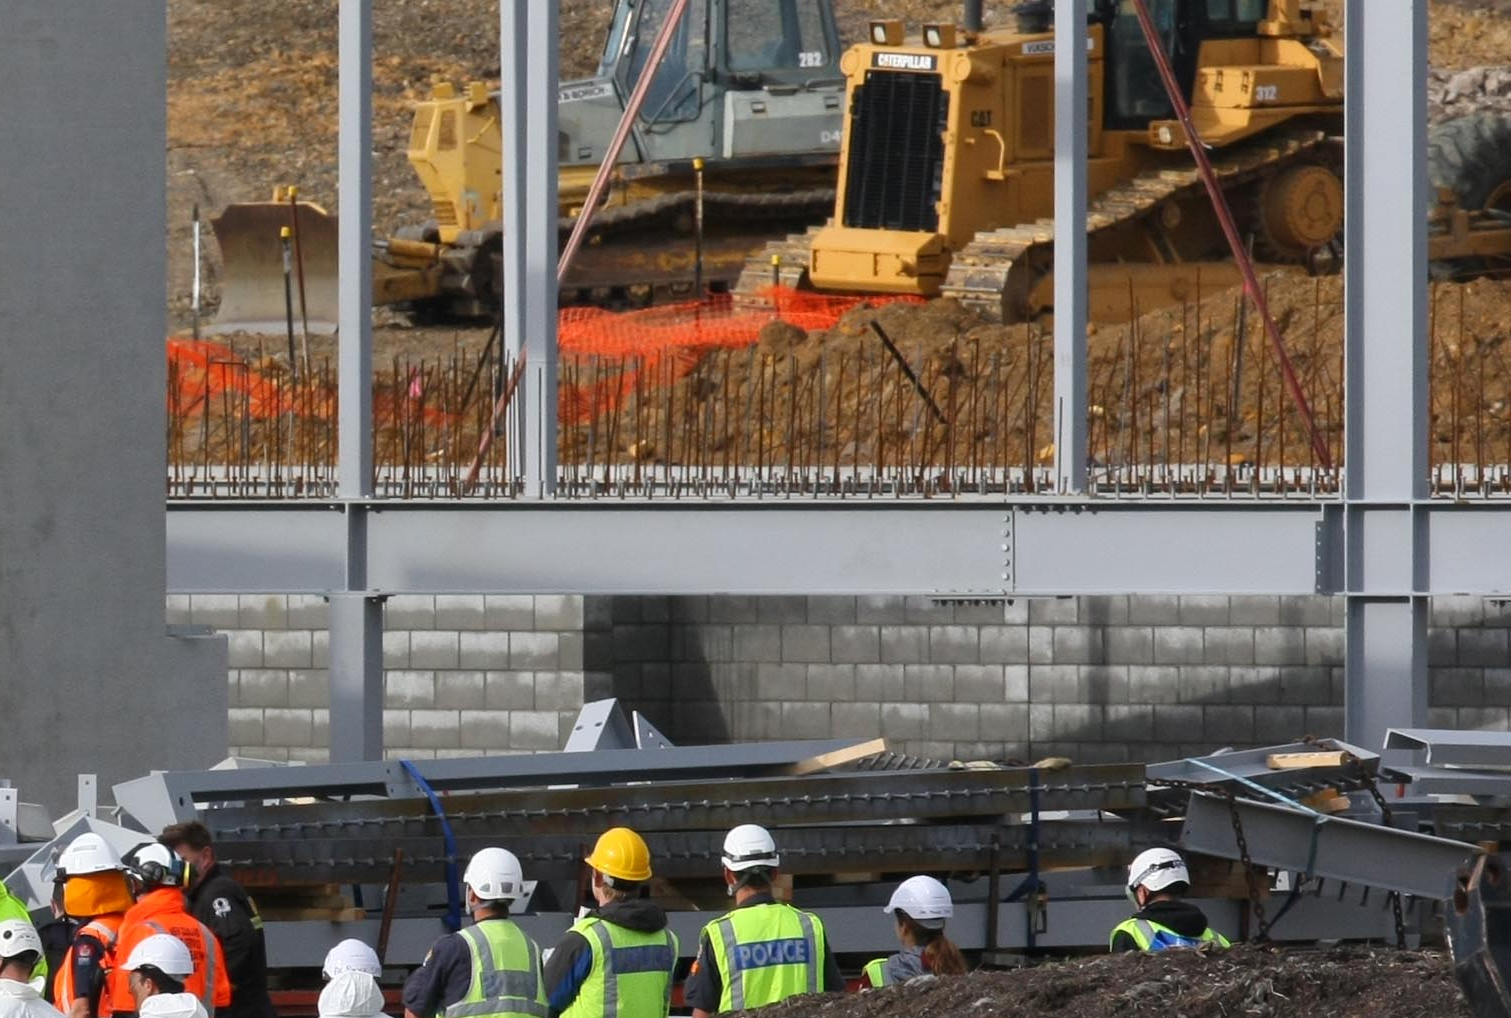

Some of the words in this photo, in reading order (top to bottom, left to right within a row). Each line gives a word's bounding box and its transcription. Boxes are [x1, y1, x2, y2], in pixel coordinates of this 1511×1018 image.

[798, 52, 823, 67] 282
[877, 53, 932, 69] CATERPILLAR
[971, 110, 992, 127] CAT
[741, 939, 805, 966] POLICE
